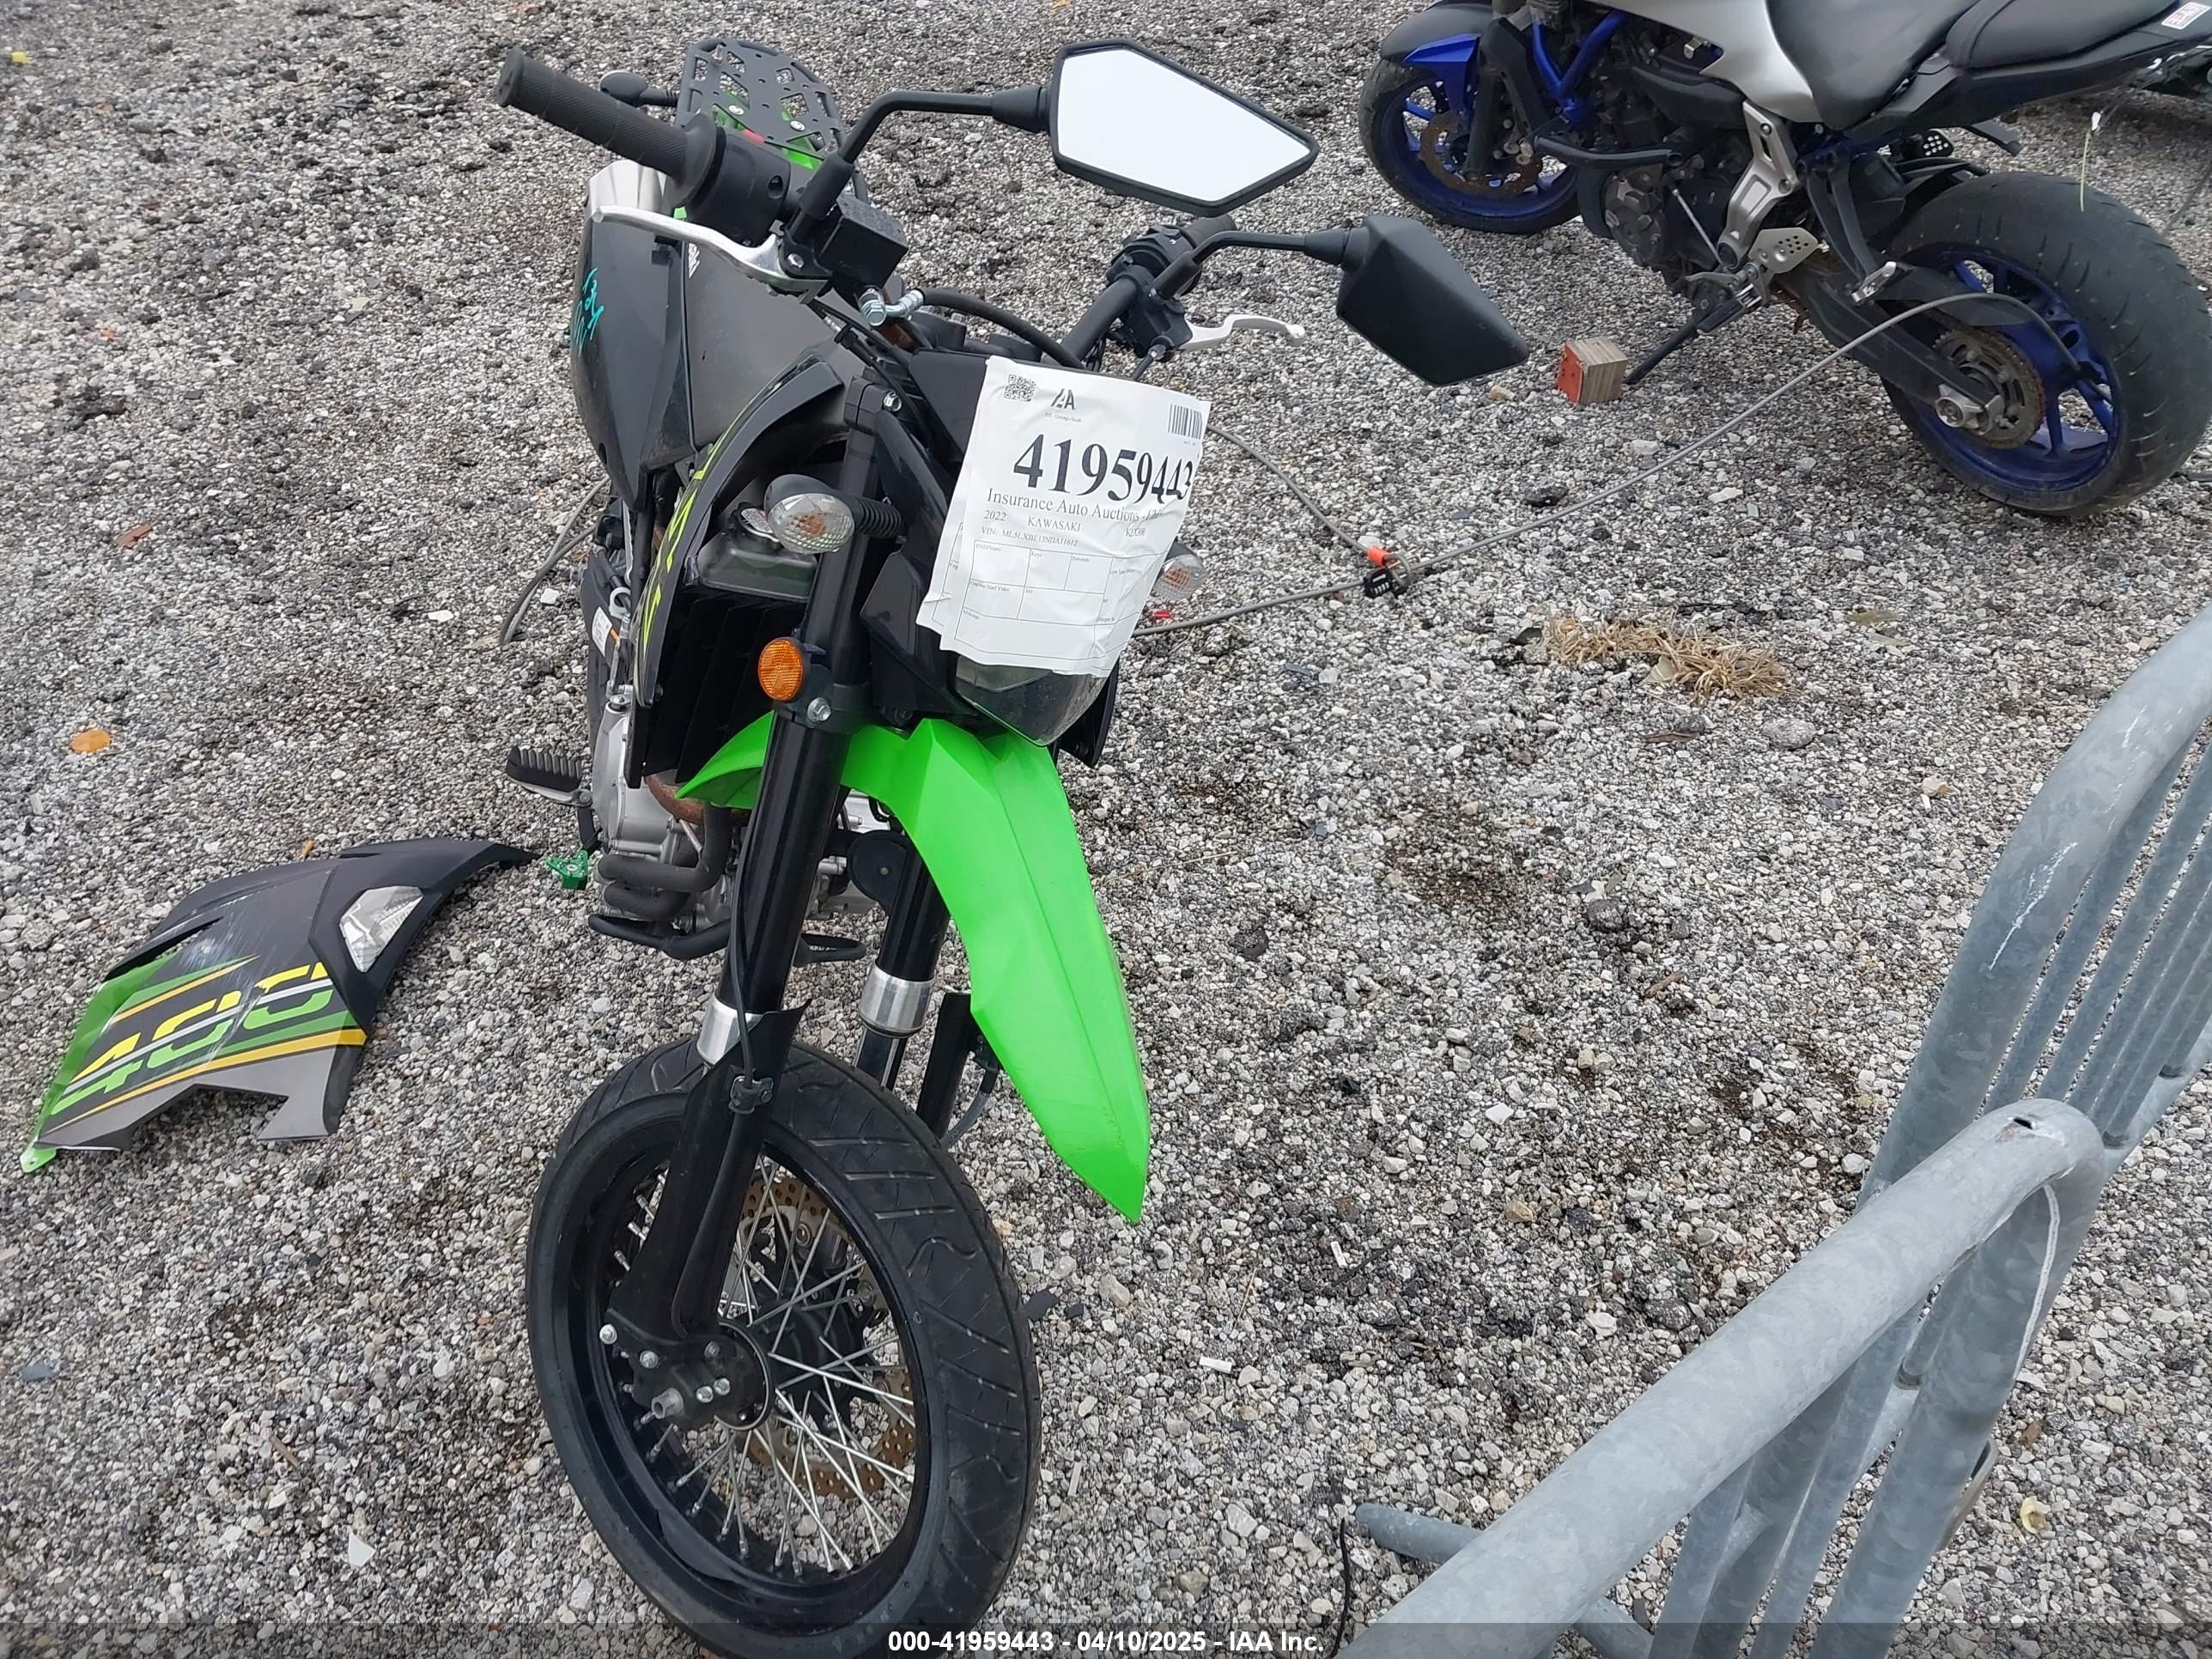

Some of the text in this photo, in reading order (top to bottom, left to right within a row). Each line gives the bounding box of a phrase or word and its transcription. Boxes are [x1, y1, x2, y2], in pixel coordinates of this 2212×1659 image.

[1013, 433, 1193, 505] 41959443
[987, 487, 1054, 512] Insurance
[1056, 498, 1088, 516] Auto
[983, 509, 1007, 522] 2022
[1027, 516, 1081, 532] KAWASAKI
